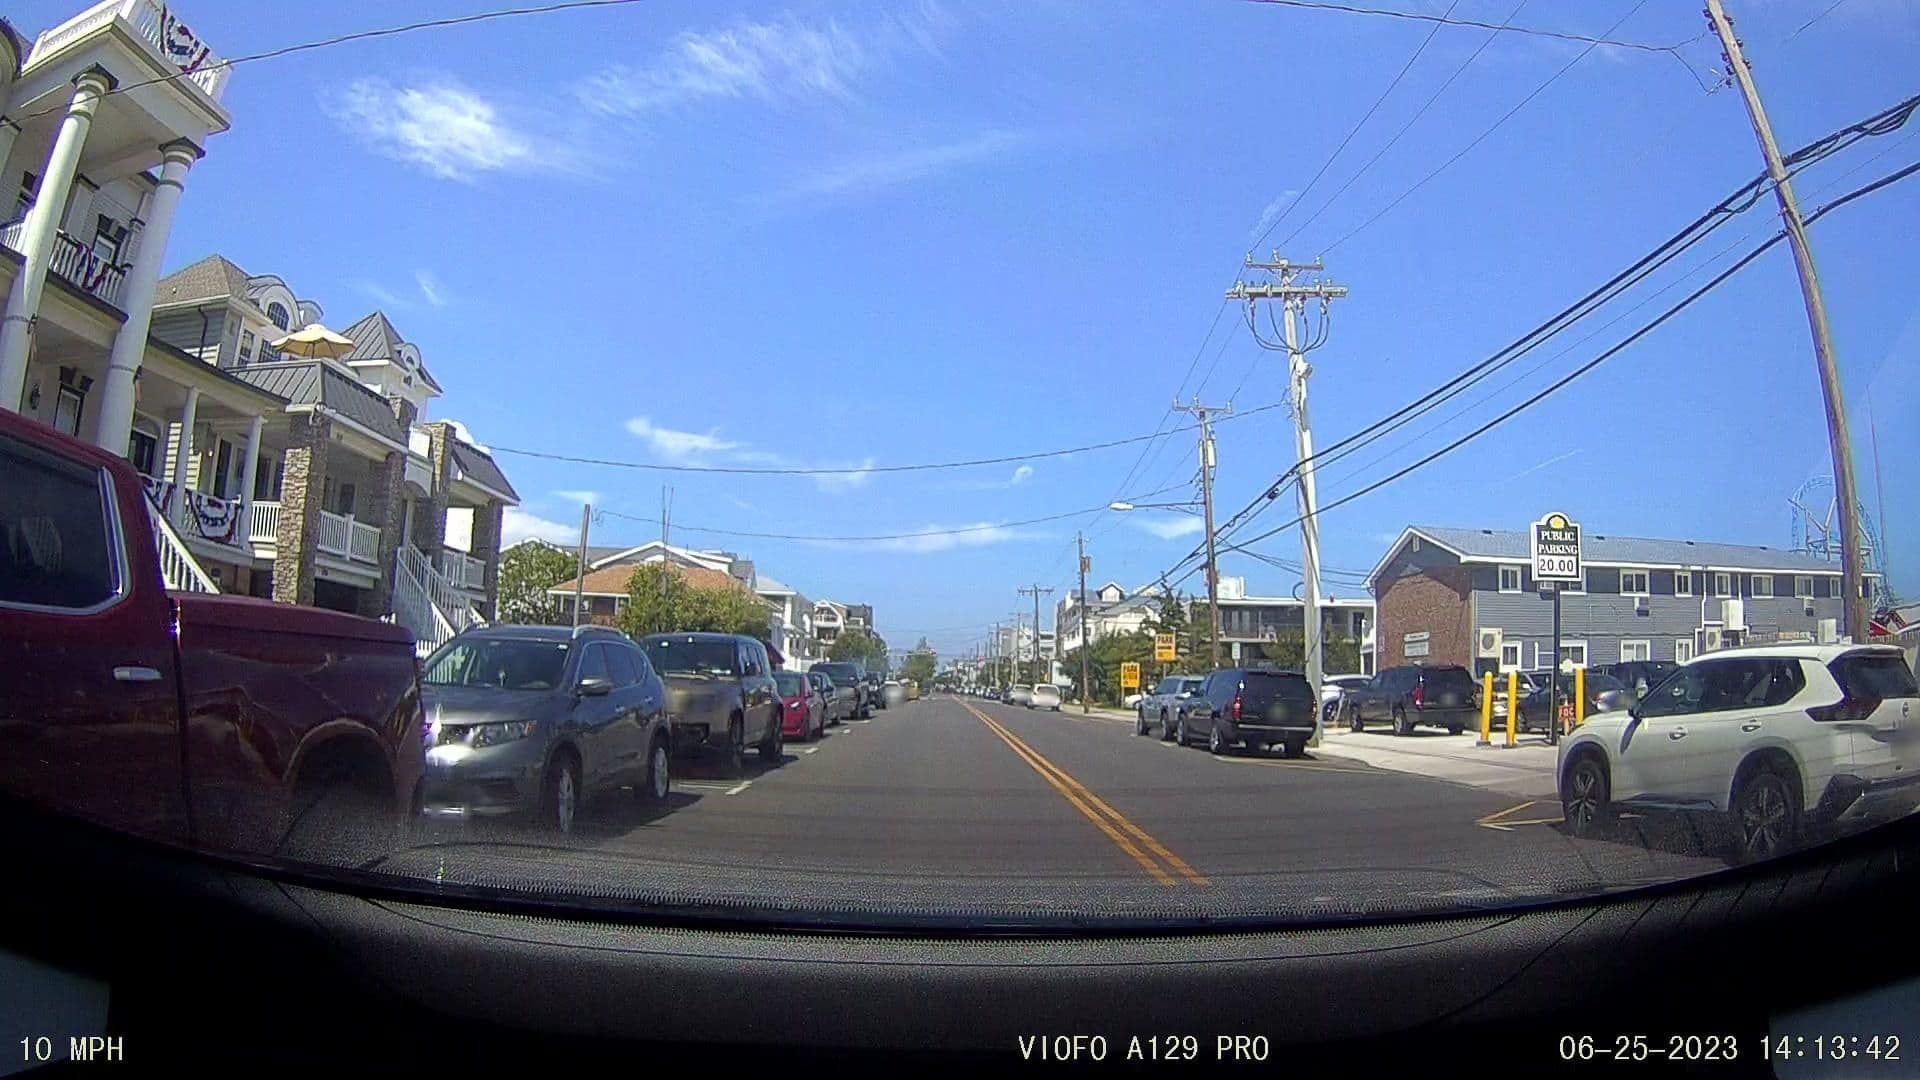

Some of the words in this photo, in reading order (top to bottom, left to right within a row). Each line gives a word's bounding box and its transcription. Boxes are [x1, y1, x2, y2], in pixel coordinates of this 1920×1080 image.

[1541, 531, 1575, 541] PUBLIC
[1538, 544, 1578, 554] PARKING
[1540, 559, 1574, 572] 20.00
